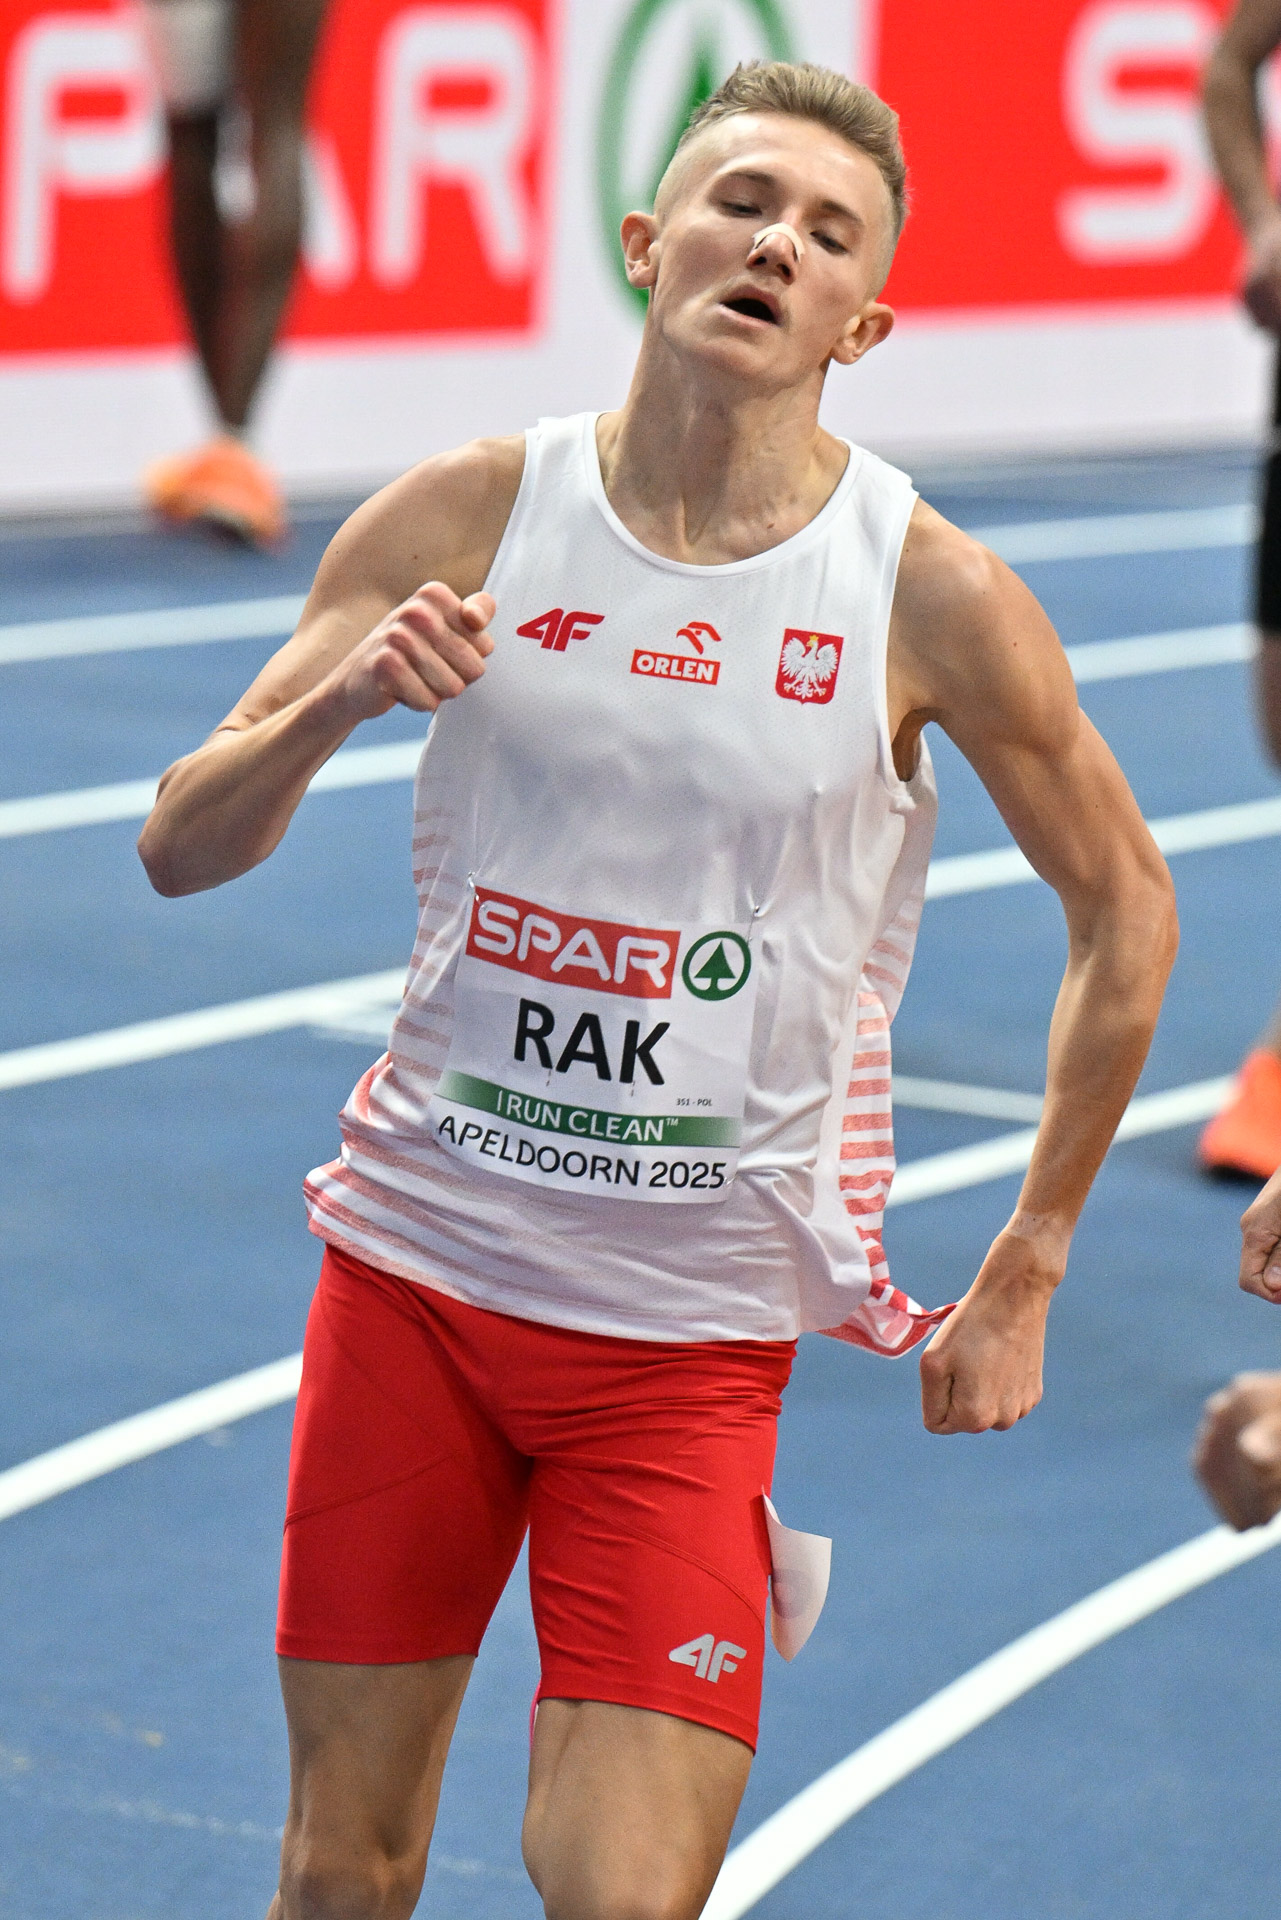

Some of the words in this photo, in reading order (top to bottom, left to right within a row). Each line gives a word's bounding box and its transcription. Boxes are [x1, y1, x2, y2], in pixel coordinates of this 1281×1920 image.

[3, 10, 536, 302] PR
[1056, 0, 1281, 262] S
[516, 608, 605, 652] 4F
[636, 654, 715, 682] ORLEN
[473, 900, 671, 989] SPAR
[513, 998, 671, 1086] RAK
[496, 1090, 505, 1112] I
[506, 1091, 562, 1129] RUN
[697, 1098, 713, 1107] POL
[438, 1115, 640, 1186] APELDOORN
[649, 1161, 727, 1189] 2025
[668, 1633, 747, 1683] 4F
